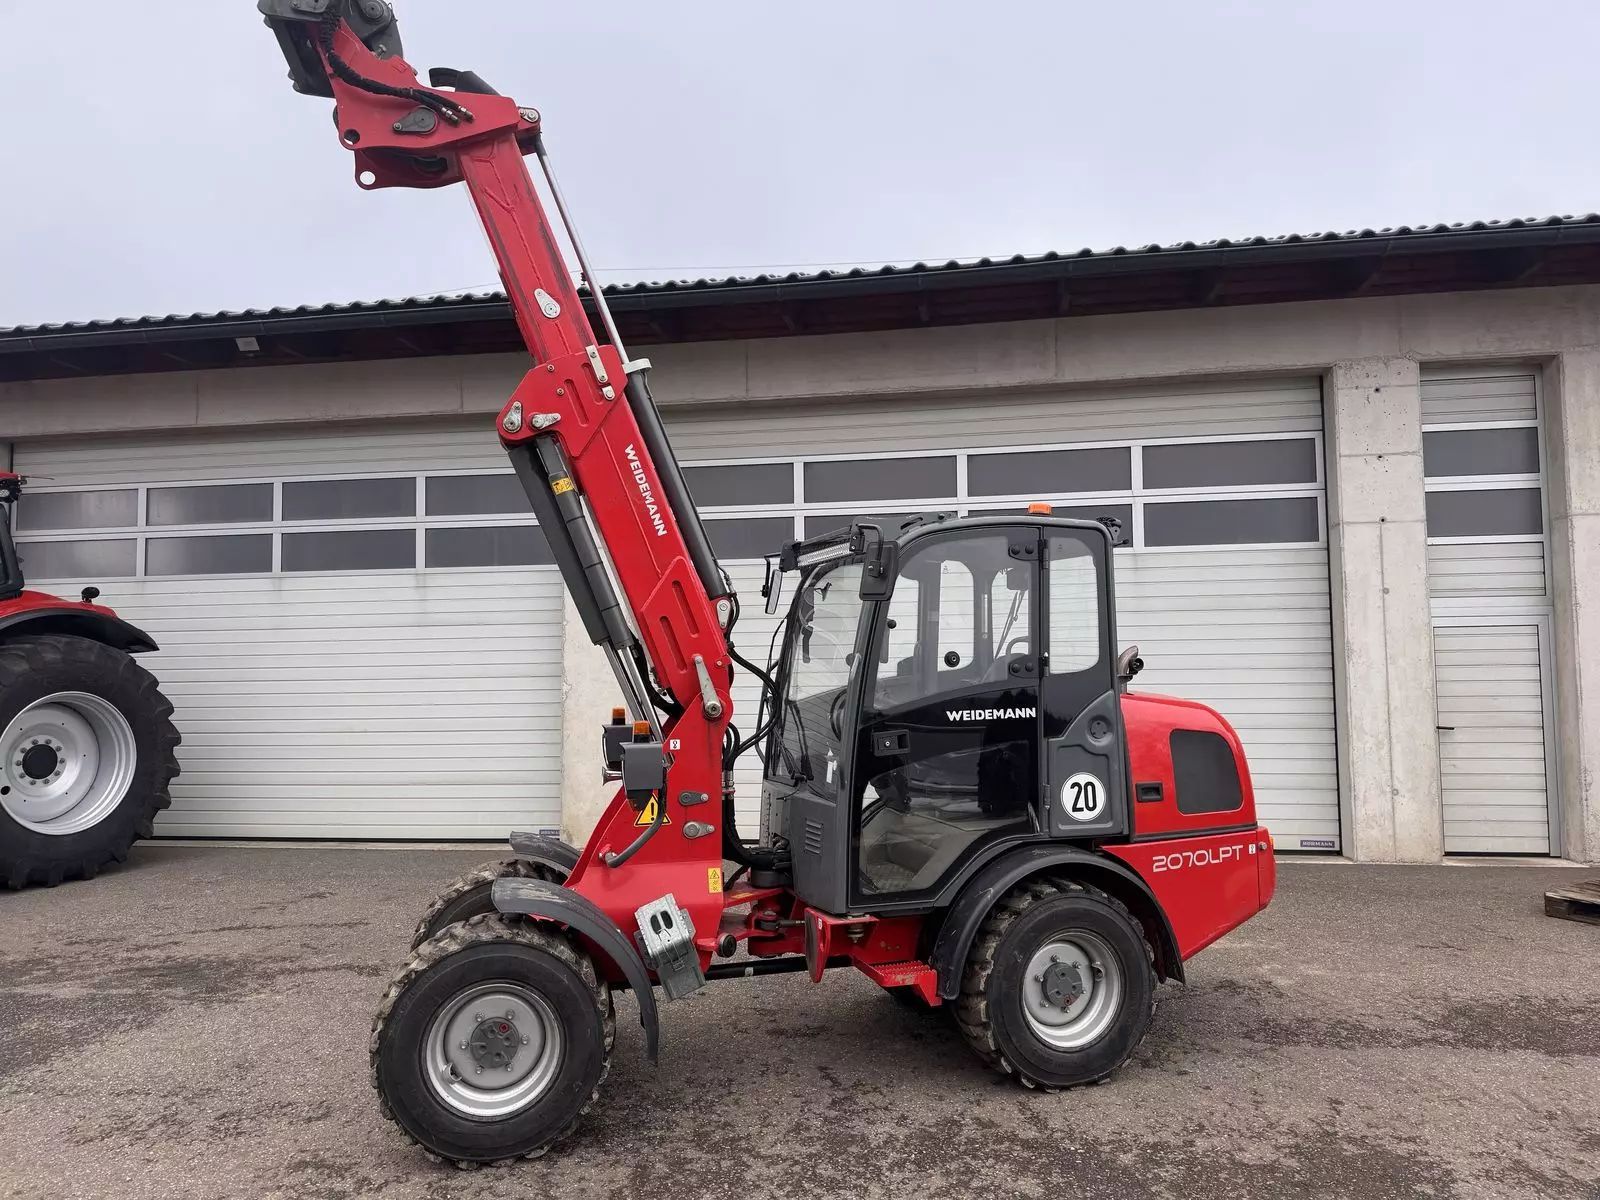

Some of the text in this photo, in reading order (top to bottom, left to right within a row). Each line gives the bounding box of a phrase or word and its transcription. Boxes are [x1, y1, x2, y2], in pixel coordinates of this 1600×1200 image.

[624, 443, 668, 537] WEIDEMANN
[946, 707, 1037, 722] WEIDEMANN
[1069, 781, 1098, 813] 20
[1152, 844, 1244, 873] 2070LPT
